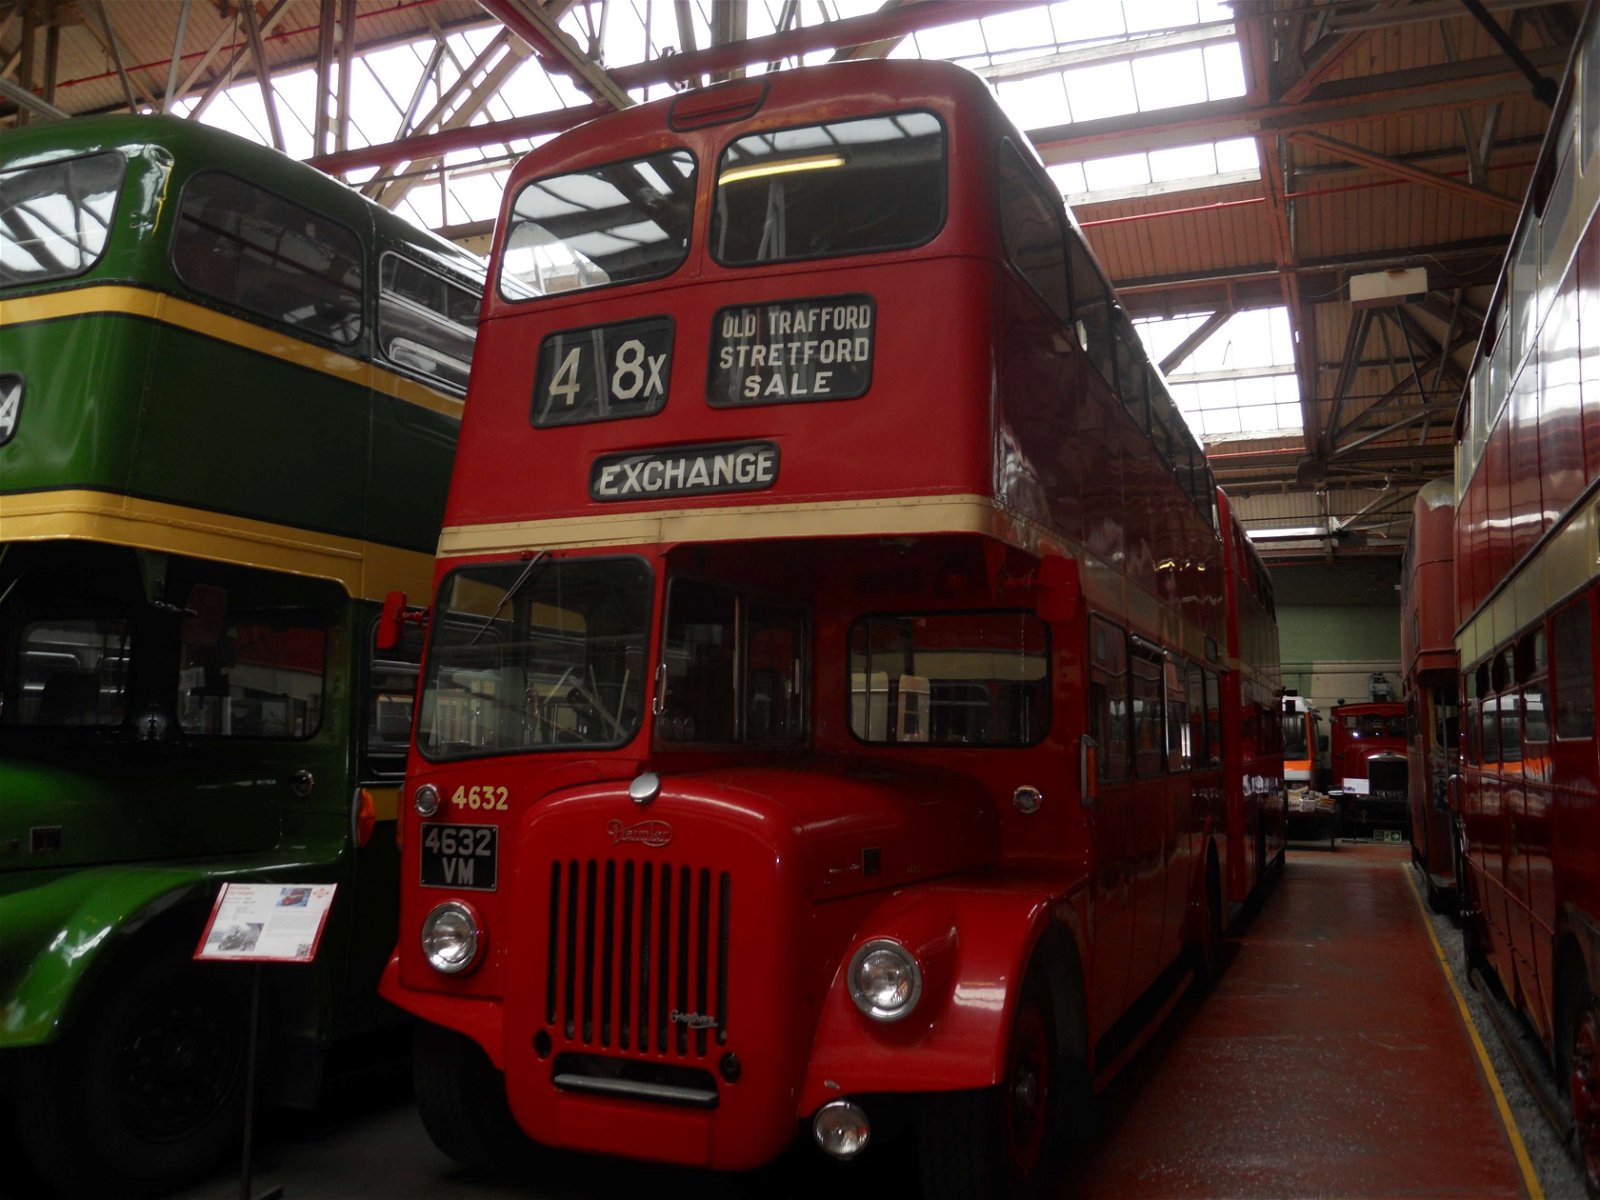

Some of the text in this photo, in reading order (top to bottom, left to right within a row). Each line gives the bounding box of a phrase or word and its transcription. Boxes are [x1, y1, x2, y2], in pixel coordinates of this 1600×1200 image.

[722, 305, 871, 338] OLD TRAFFORD
[719, 337, 869, 369] STRETFORD
[549, 347, 581, 406] 4
[743, 371, 833, 398] SALE
[599, 451, 775, 495] EXCHANGE
[451, 785, 509, 811] 4632
[424, 828, 492, 856] 4632
[441, 857, 475, 885] VM
